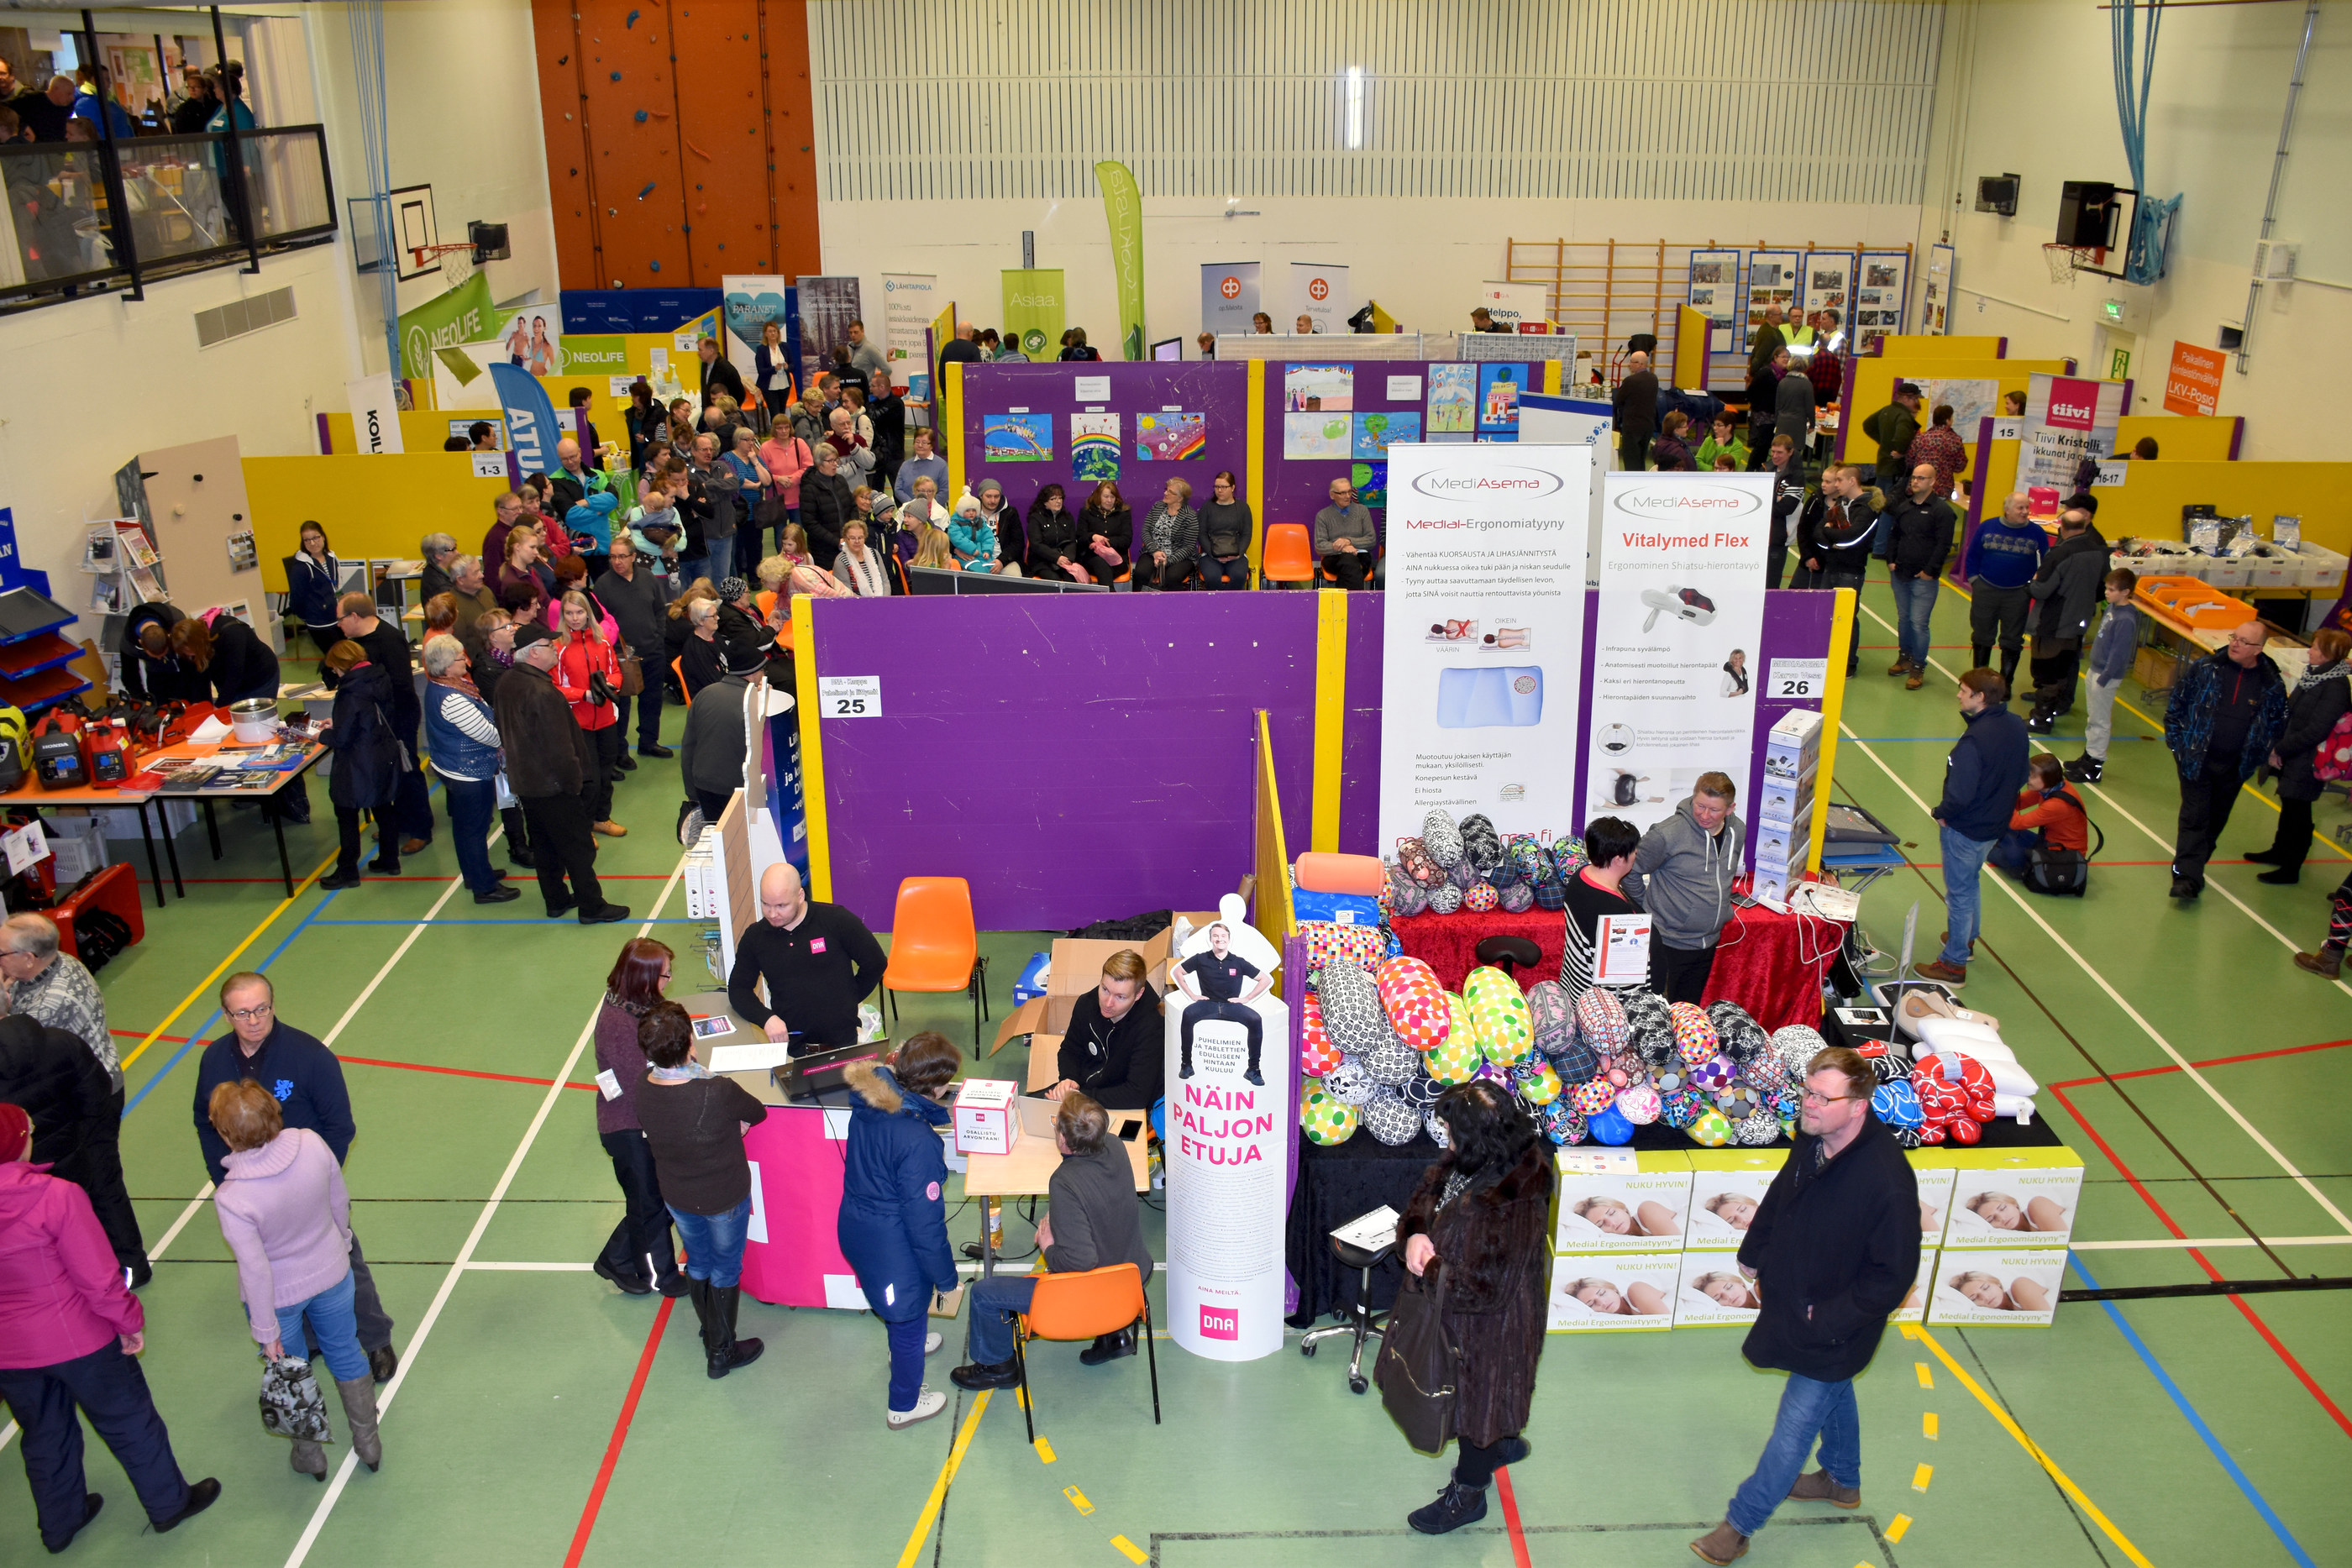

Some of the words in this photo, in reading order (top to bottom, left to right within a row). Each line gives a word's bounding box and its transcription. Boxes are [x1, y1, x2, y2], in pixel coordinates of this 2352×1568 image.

[1010, 292, 1058, 307] Asiaa.
[732, 305, 777, 314] PARANET
[1486, 307, 1522, 319] Helppo,
[431, 307, 482, 349] NEOLIFE
[573, 351, 625, 363] NEOLIFE
[2051, 403, 2091, 419] tiivi
[2034, 431, 2055, 444] Tiivi
[2057, 434, 2101, 450] Kristalli
[2033, 446, 2066, 459] ikkunat
[2066, 451, 2076, 462] ja
[480, 466, 501, 475] 1-3
[2098, 474, 2119, 483] 16-17
[1431, 478, 1540, 489] MediAsema
[1633, 496, 1739, 508] MediAsema
[1406, 518, 1565, 532] Medial-Ergonomiatyyny
[1622, 532, 1709, 551] Vitalymed
[1714, 532, 1750, 547] Flex
[1496, 549, 1557, 558] LIHASJÄNNITYSTÄ
[1494, 564, 1511, 573] pään
[1512, 564, 1519, 573] ja
[1608, 561, 1669, 572] Ergonominen
[1672, 561, 1760, 572] Shiatsu-hierontavyö
[1498, 576, 1534, 585] täydellisen
[1534, 576, 1555, 585] levon,
[1405, 590, 1421, 599] jotta
[1532, 590, 1562, 598] yöunista
[1782, 680, 1809, 695] 26
[837, 699, 866, 714] 25
[1453, 753, 1481, 761] jokaisen
[1482, 752, 1512, 761] käyttäjän
[1445, 761, 1484, 770] yksilöllisesti.
[785, 773, 794, 786] ja
[1414, 798, 1477, 807] Allergiaystävällinen
[812, 941, 825, 950] DNA
[1198, 1036, 1242, 1046] PUHELIMIEN
[1204, 1044, 1247, 1053] TABLETTIEN
[1199, 1051, 1241, 1060] EDULLISEEN
[1203, 1058, 1236, 1067] HINTAAN
[1205, 1066, 1234, 1074] KUULUU
[1185, 1083, 1254, 1111] NÄIN
[1173, 1102, 1273, 1139] PALJON
[1181, 1134, 1263, 1166] ETUJA
[1918, 1177, 1950, 1185] HYVIN!
[2047, 1176, 2079, 1184] HYVIN!
[1656, 1181, 1688, 1189] HYVIN!
[2001, 1257, 2029, 1266] NUKU
[2029, 1257, 2062, 1266] HYVIN!
[1645, 1262, 1677, 1271] HYVIN!
[1197, 1285, 1214, 1294] AINA
[1717, 1313, 1760, 1322] Ergonomi
[1939, 1312, 1970, 1320] Medial
[1204, 1314, 1234, 1331] DNA
[1557, 1319, 1590, 1327] Medial
